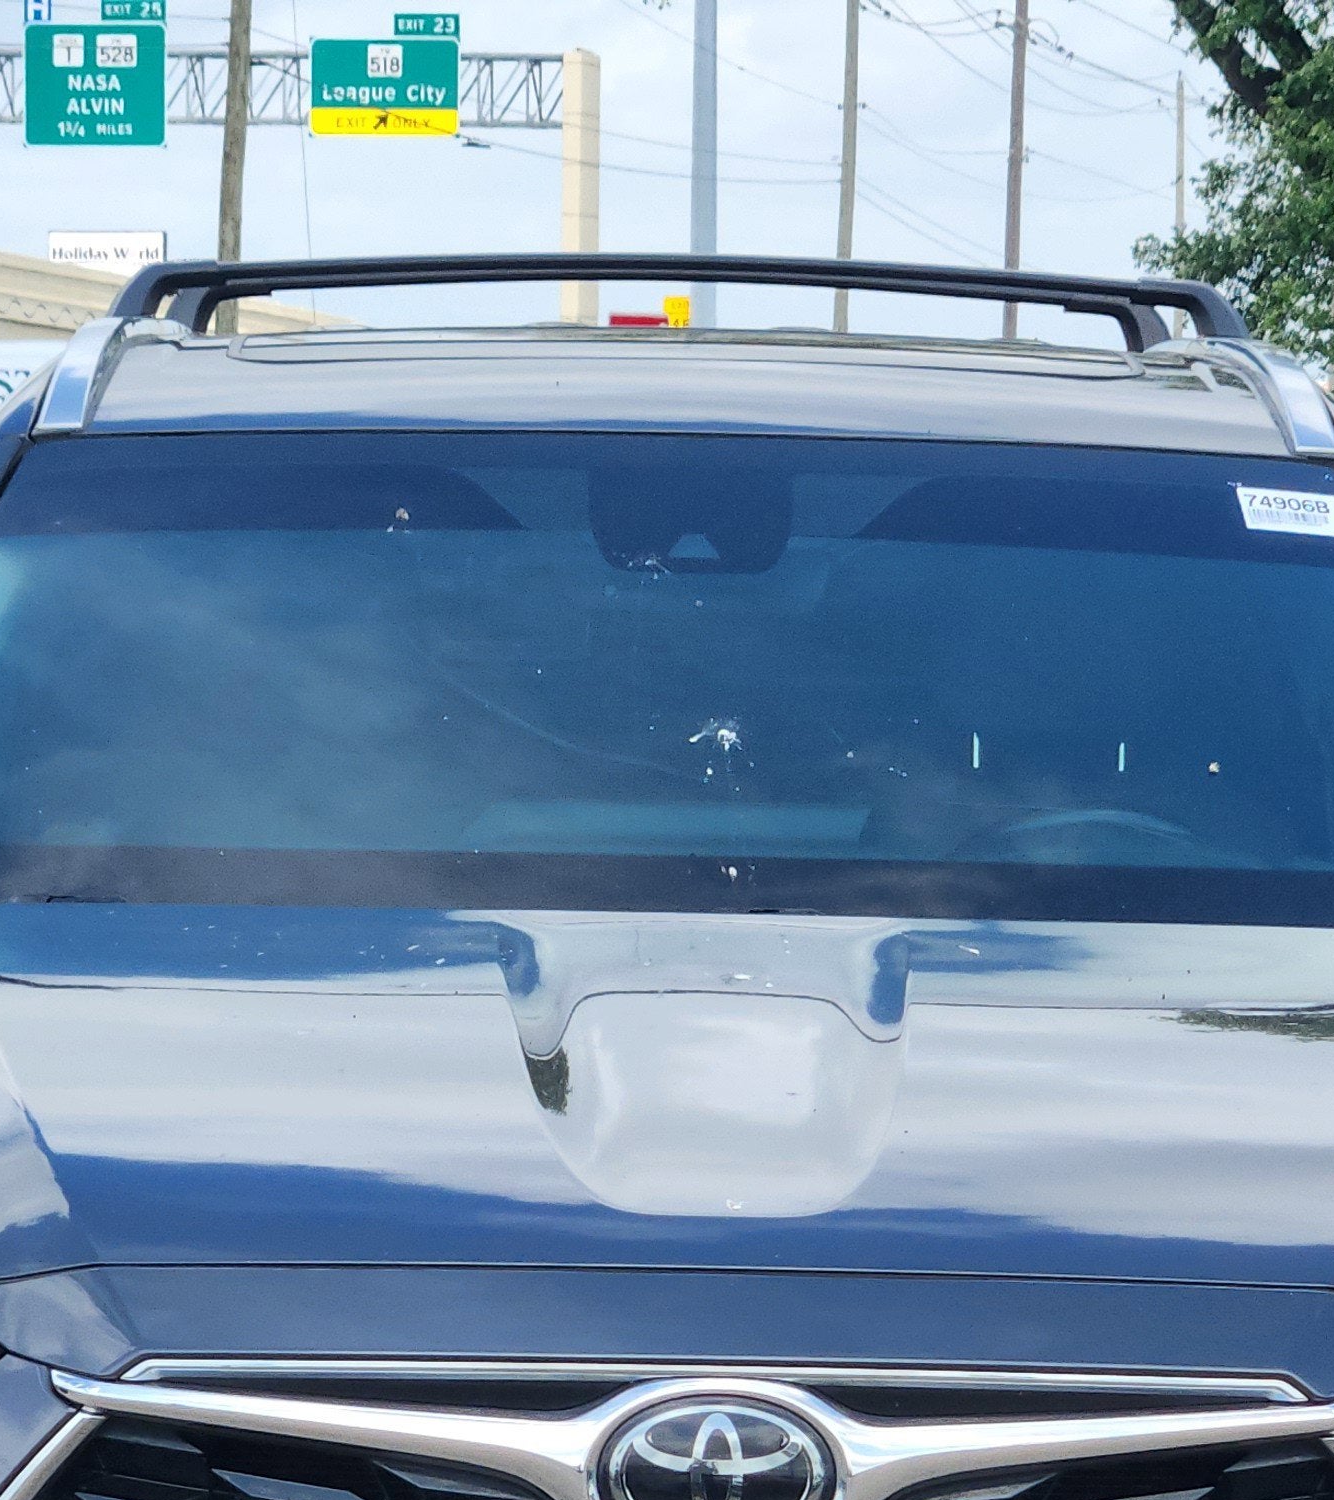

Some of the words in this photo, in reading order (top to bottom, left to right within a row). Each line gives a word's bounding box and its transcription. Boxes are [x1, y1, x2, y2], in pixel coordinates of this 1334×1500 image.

[397, 18, 425, 32] EXIT
[433, 17, 456, 34] 23
[100, 46, 134, 64] 528
[370, 56, 401, 75] 518
[67, 74, 122, 92] NASA
[322, 83, 396, 105] League
[406, 83, 447, 106] City
[67, 97, 125, 116] ALVIN
[95, 123, 133, 136] MILES
[336, 117, 367, 129] EXIT
[393, 116, 431, 129] ONLY
[52, 246, 109, 261] Holiday
[1243, 493, 1330, 515] 74906B
